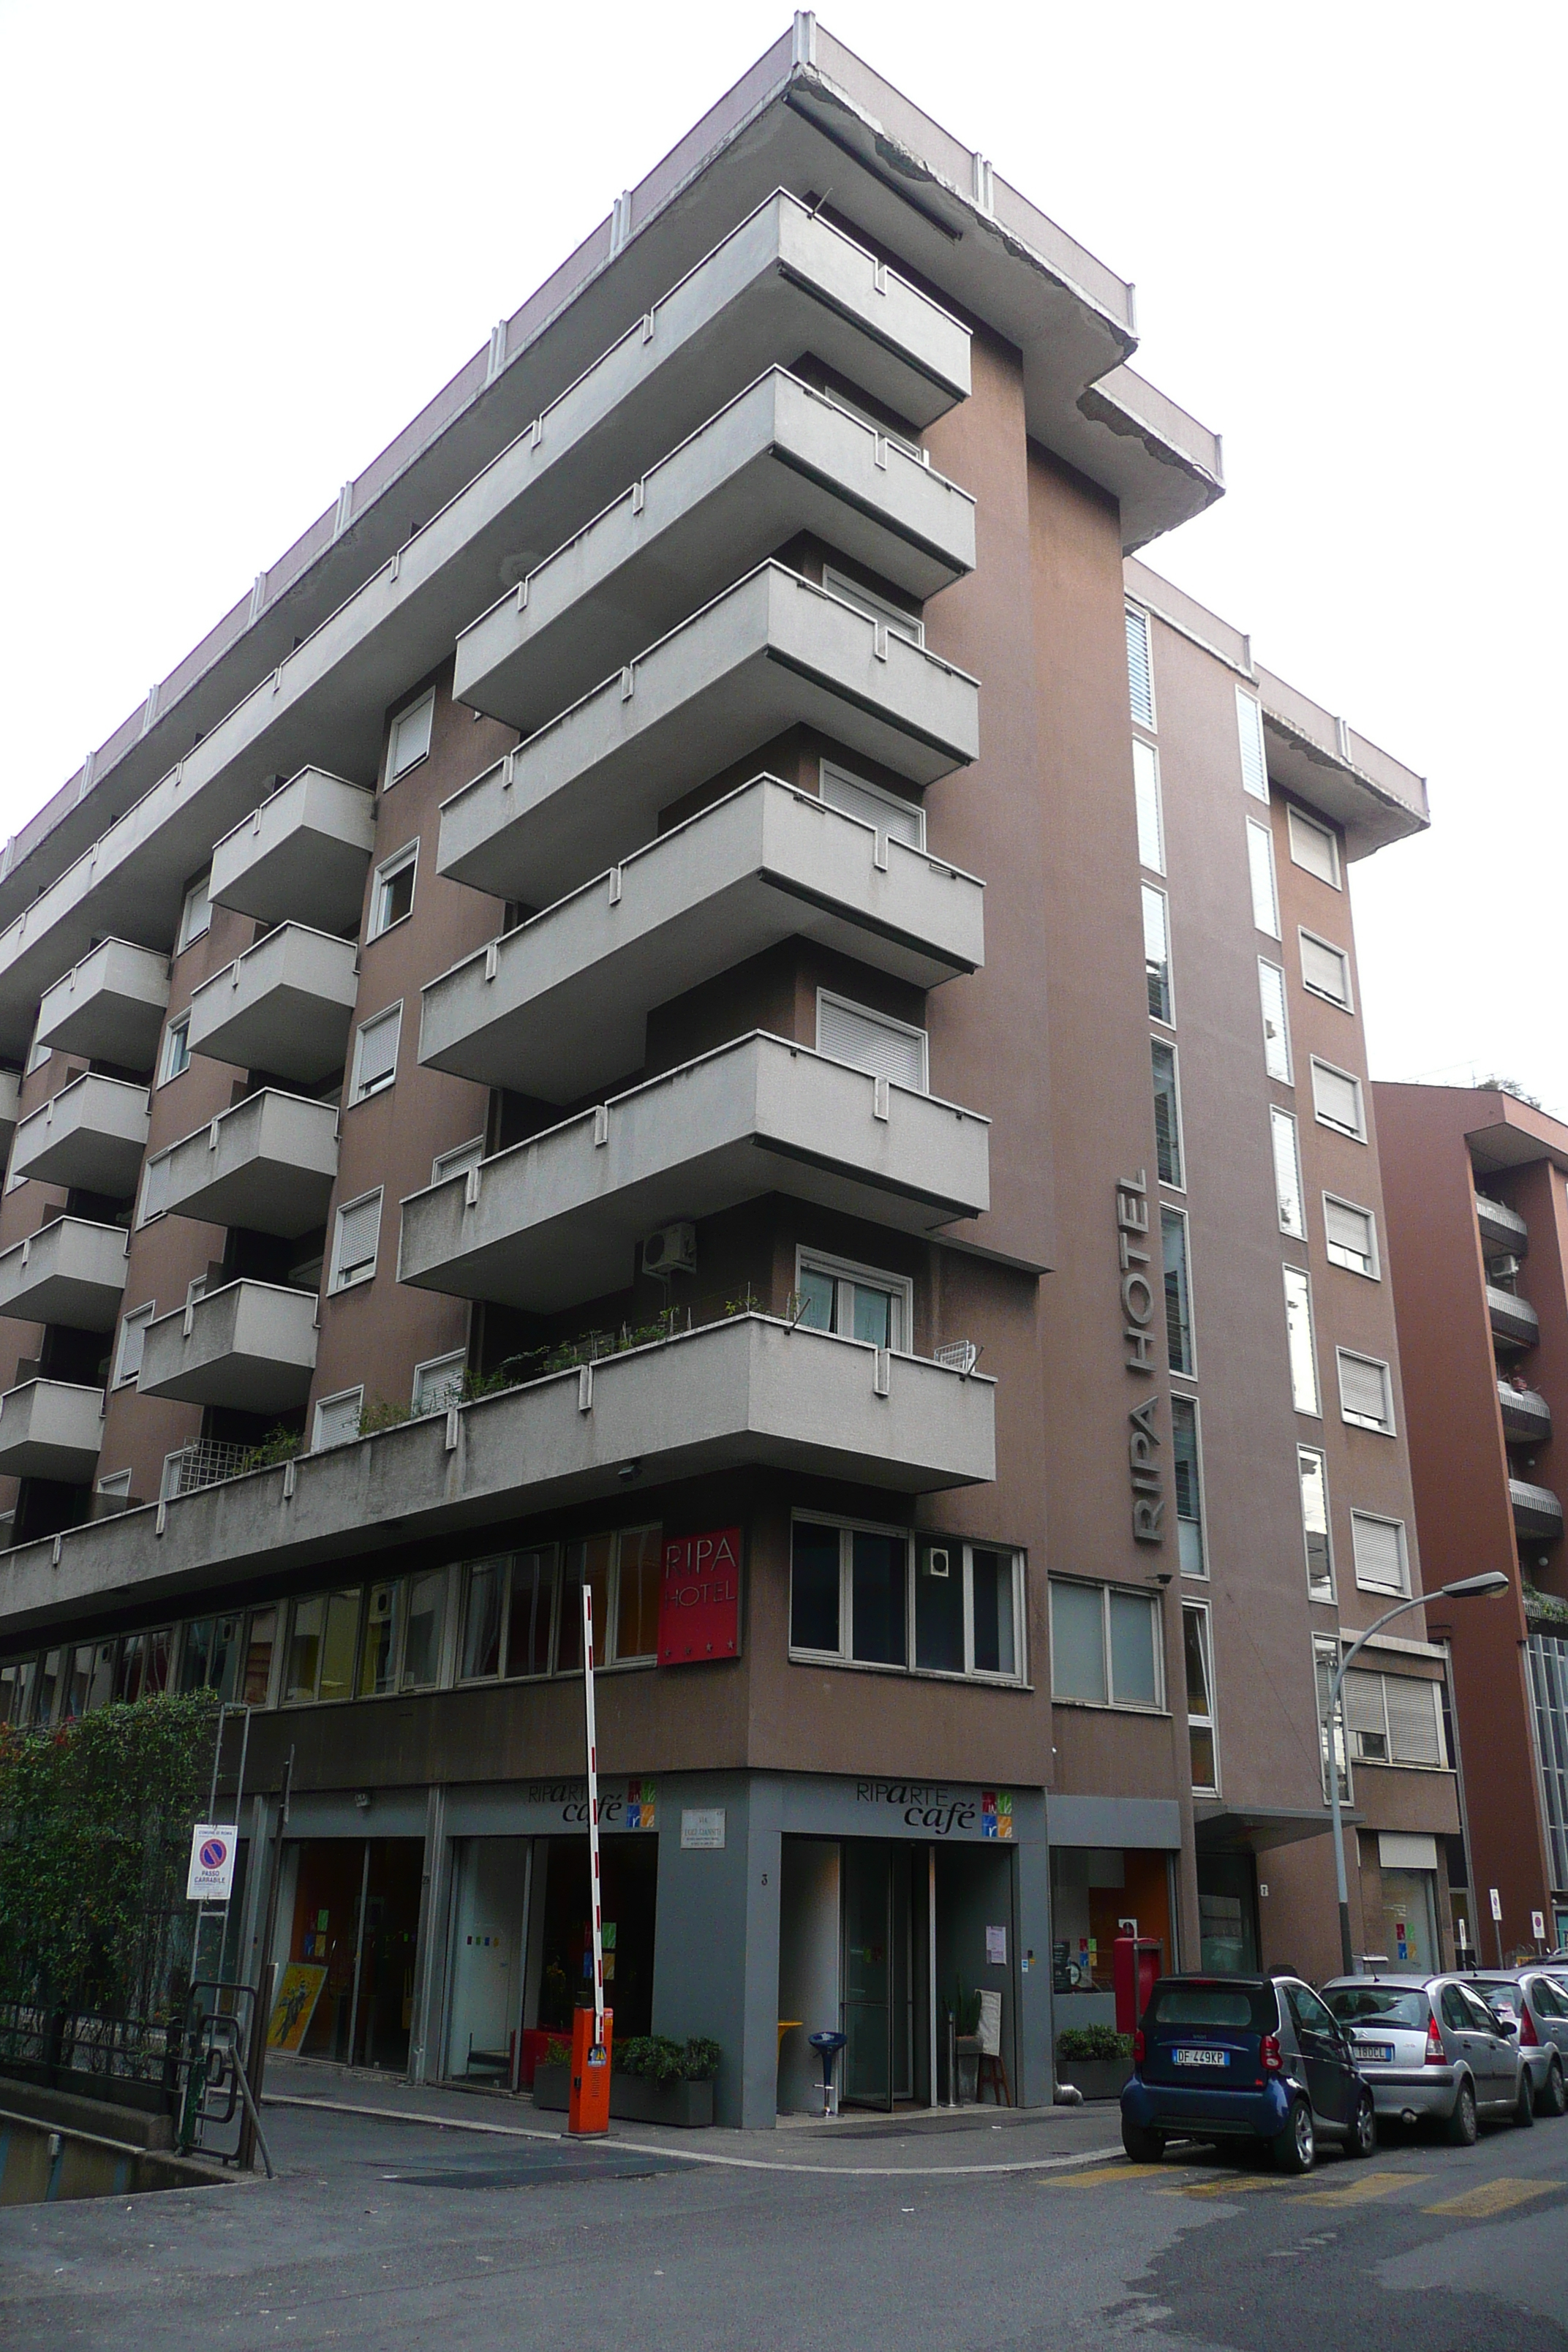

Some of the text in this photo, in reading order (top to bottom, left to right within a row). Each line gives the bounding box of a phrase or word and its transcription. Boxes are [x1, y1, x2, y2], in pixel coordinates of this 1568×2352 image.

[1117, 1168, 1165, 1544] RIPA HOTEL
[666, 1537, 736, 1579] RIPA
[664, 1580, 736, 1610] HOTEL
[904, 1802, 976, 1835] café
[1178, 2051, 1224, 2065] DF 449KP
